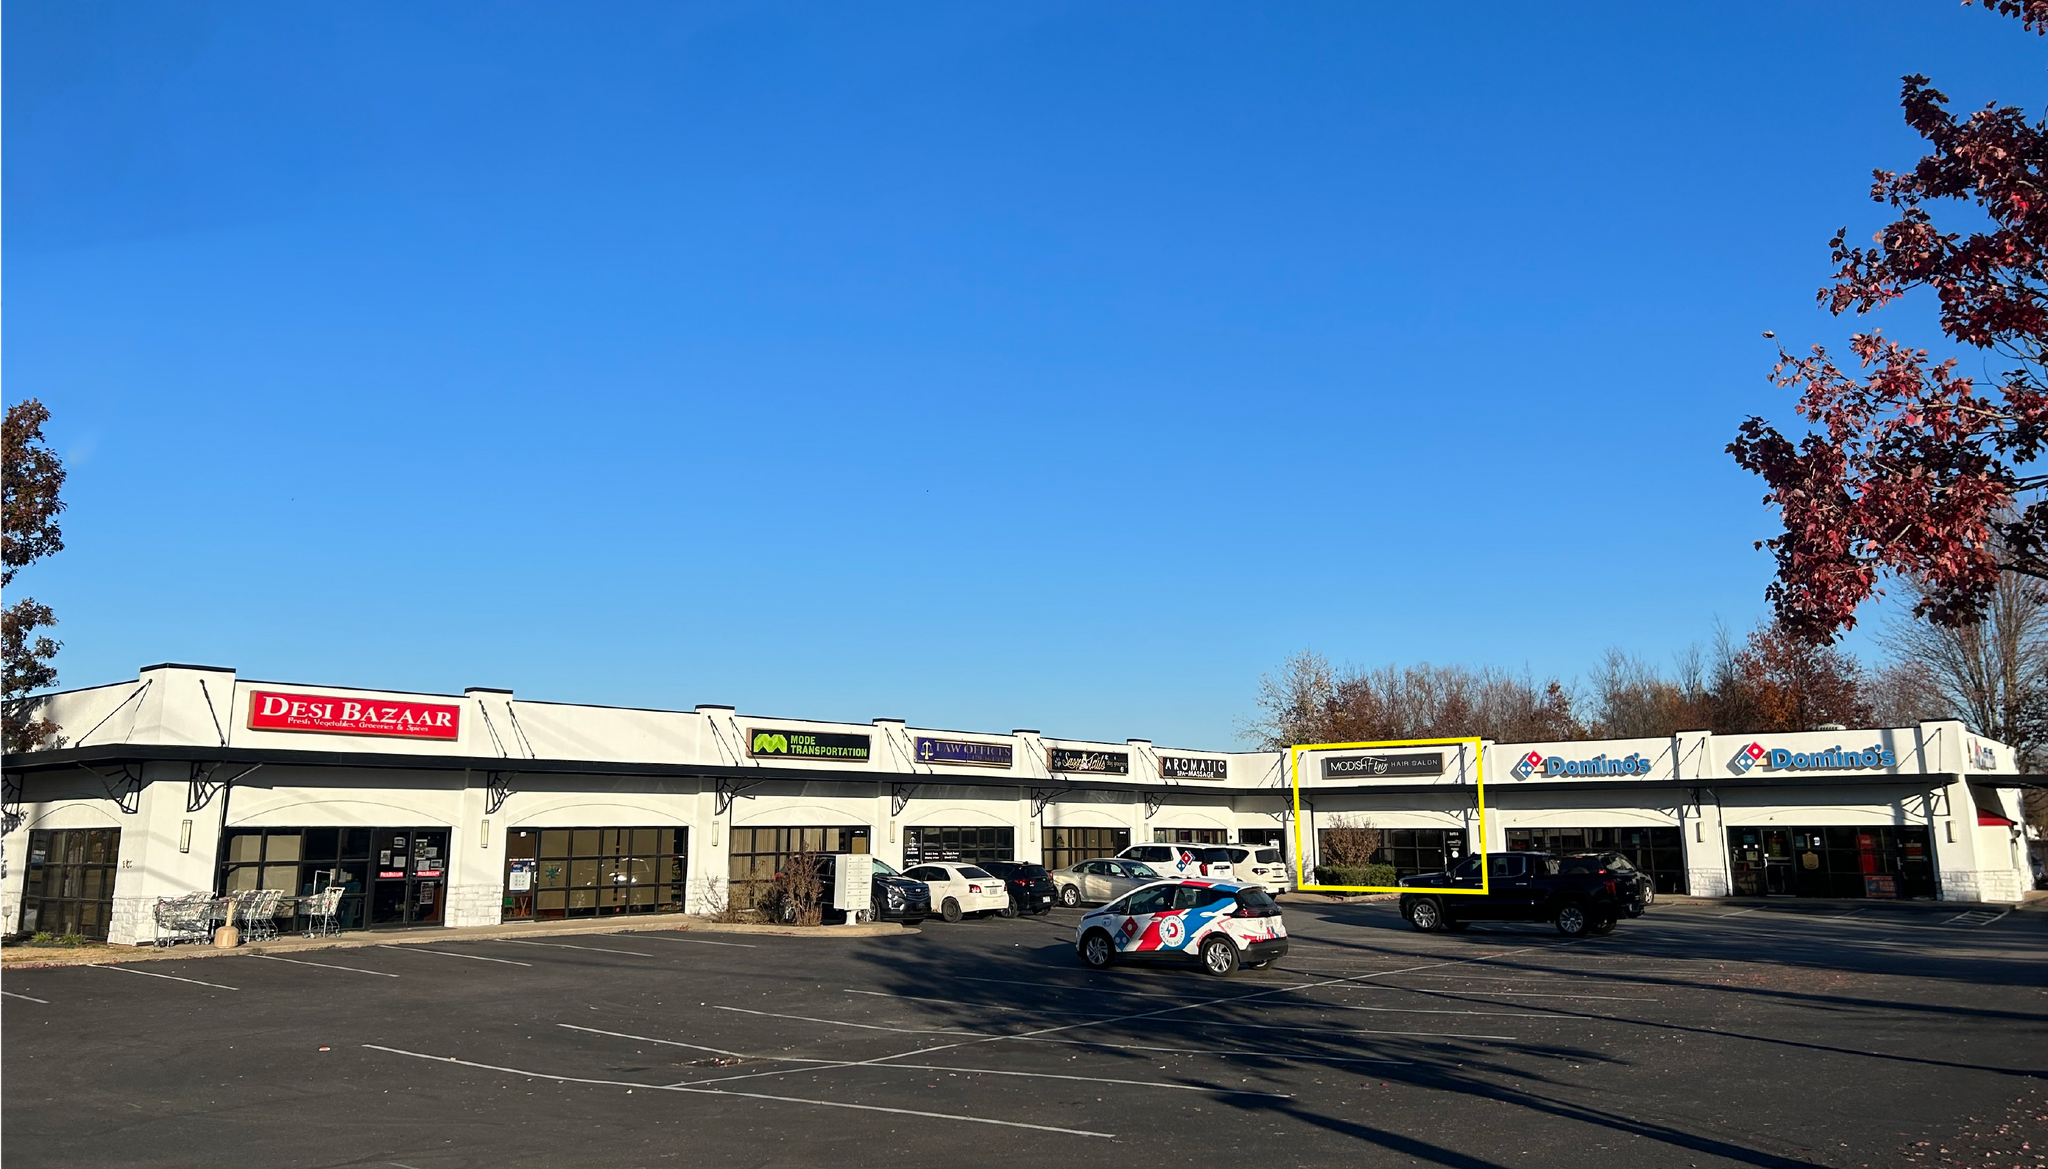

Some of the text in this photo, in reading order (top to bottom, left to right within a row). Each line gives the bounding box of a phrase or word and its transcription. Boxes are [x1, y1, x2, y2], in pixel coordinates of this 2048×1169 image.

[260, 696, 453, 727] DESI BAZAAR
[287, 717, 311, 725] Fresh
[359, 722, 394, 731] Groceries
[406, 724, 429, 732] Spices
[790, 735, 816, 745] MODE
[790, 745, 868, 757] TRANSPORTATION
[935, 742, 1011, 756] LAW OFFICES
[1771, 744, 1896, 769] Domino's
[1165, 758, 1225, 773] AROMATIC
[1330, 760, 1368, 772] MODISH
[1411, 759, 1438, 767] SALON
[1547, 752, 1651, 776] Domino's
